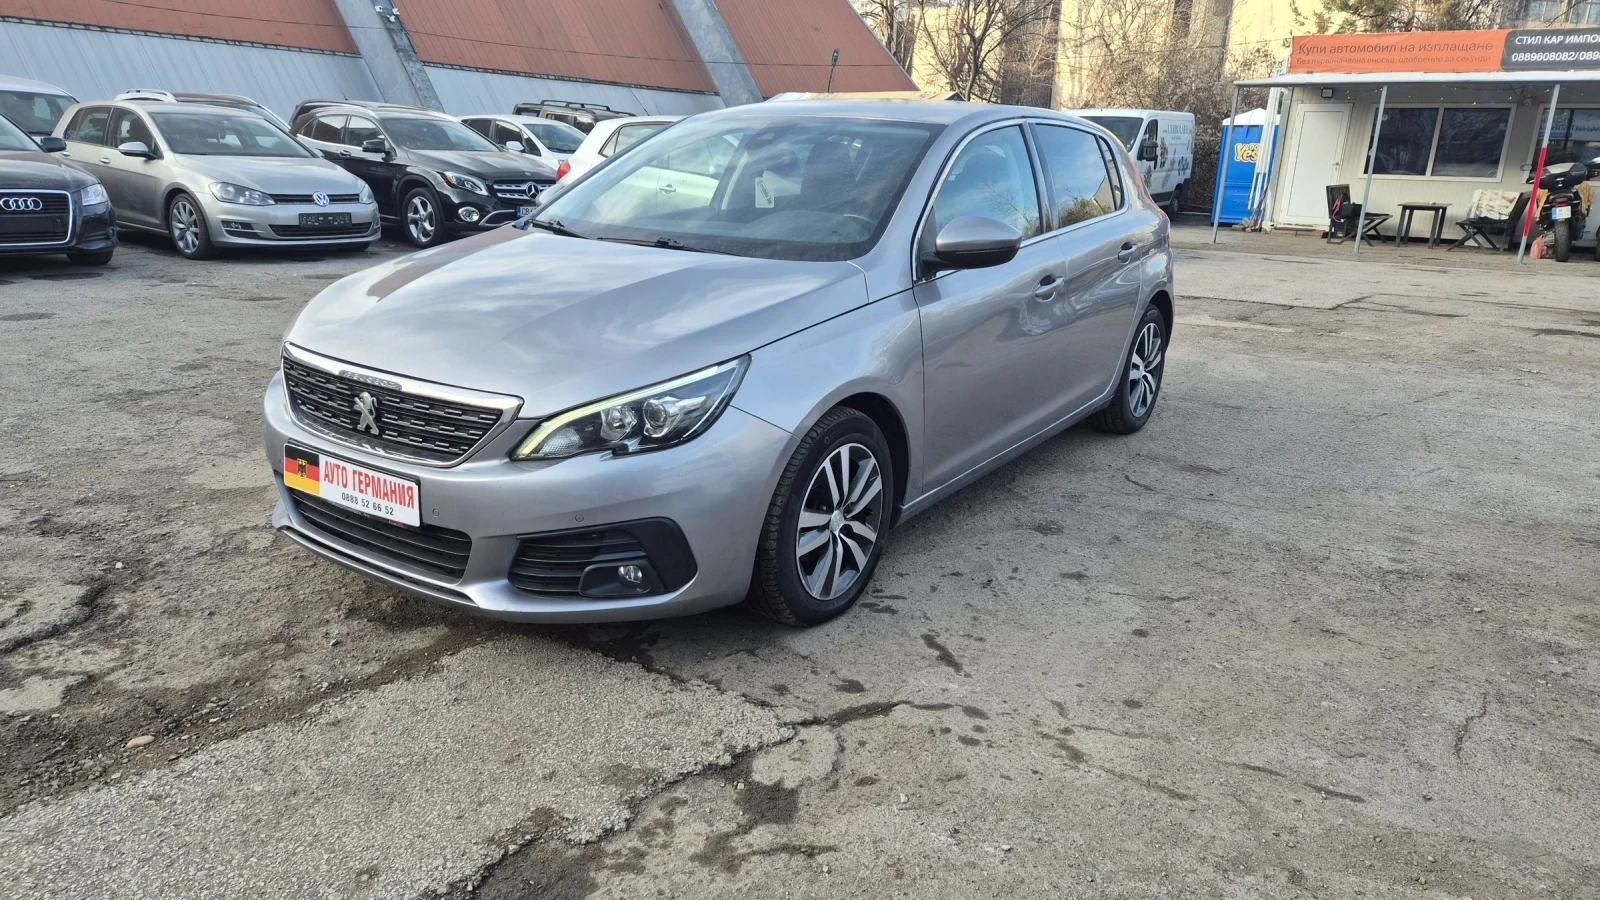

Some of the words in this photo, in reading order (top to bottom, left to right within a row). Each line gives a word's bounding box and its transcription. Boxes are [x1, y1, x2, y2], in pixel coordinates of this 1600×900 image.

[1515, 35, 1542, 45] СТИЛ
[1544, 35, 1564, 44] КАР
[1565, 34, 1600, 44] ИМПО
[1298, 44, 1327, 56] Купи
[1329, 43, 1396, 54] автомобил
[1399, 43, 1415, 52] на
[1418, 42, 1493, 52] изплащане
[1511, 51, 1600, 62] 0889608082/089
[323, 460, 348, 489] АУТО
[352, 468, 415, 509] ГЕРМАНИЯ
[341, 491, 359, 505] 0888
[361, 499, 370, 508] 52
[372, 502, 382, 513] 66
[384, 506, 394, 516] 52
